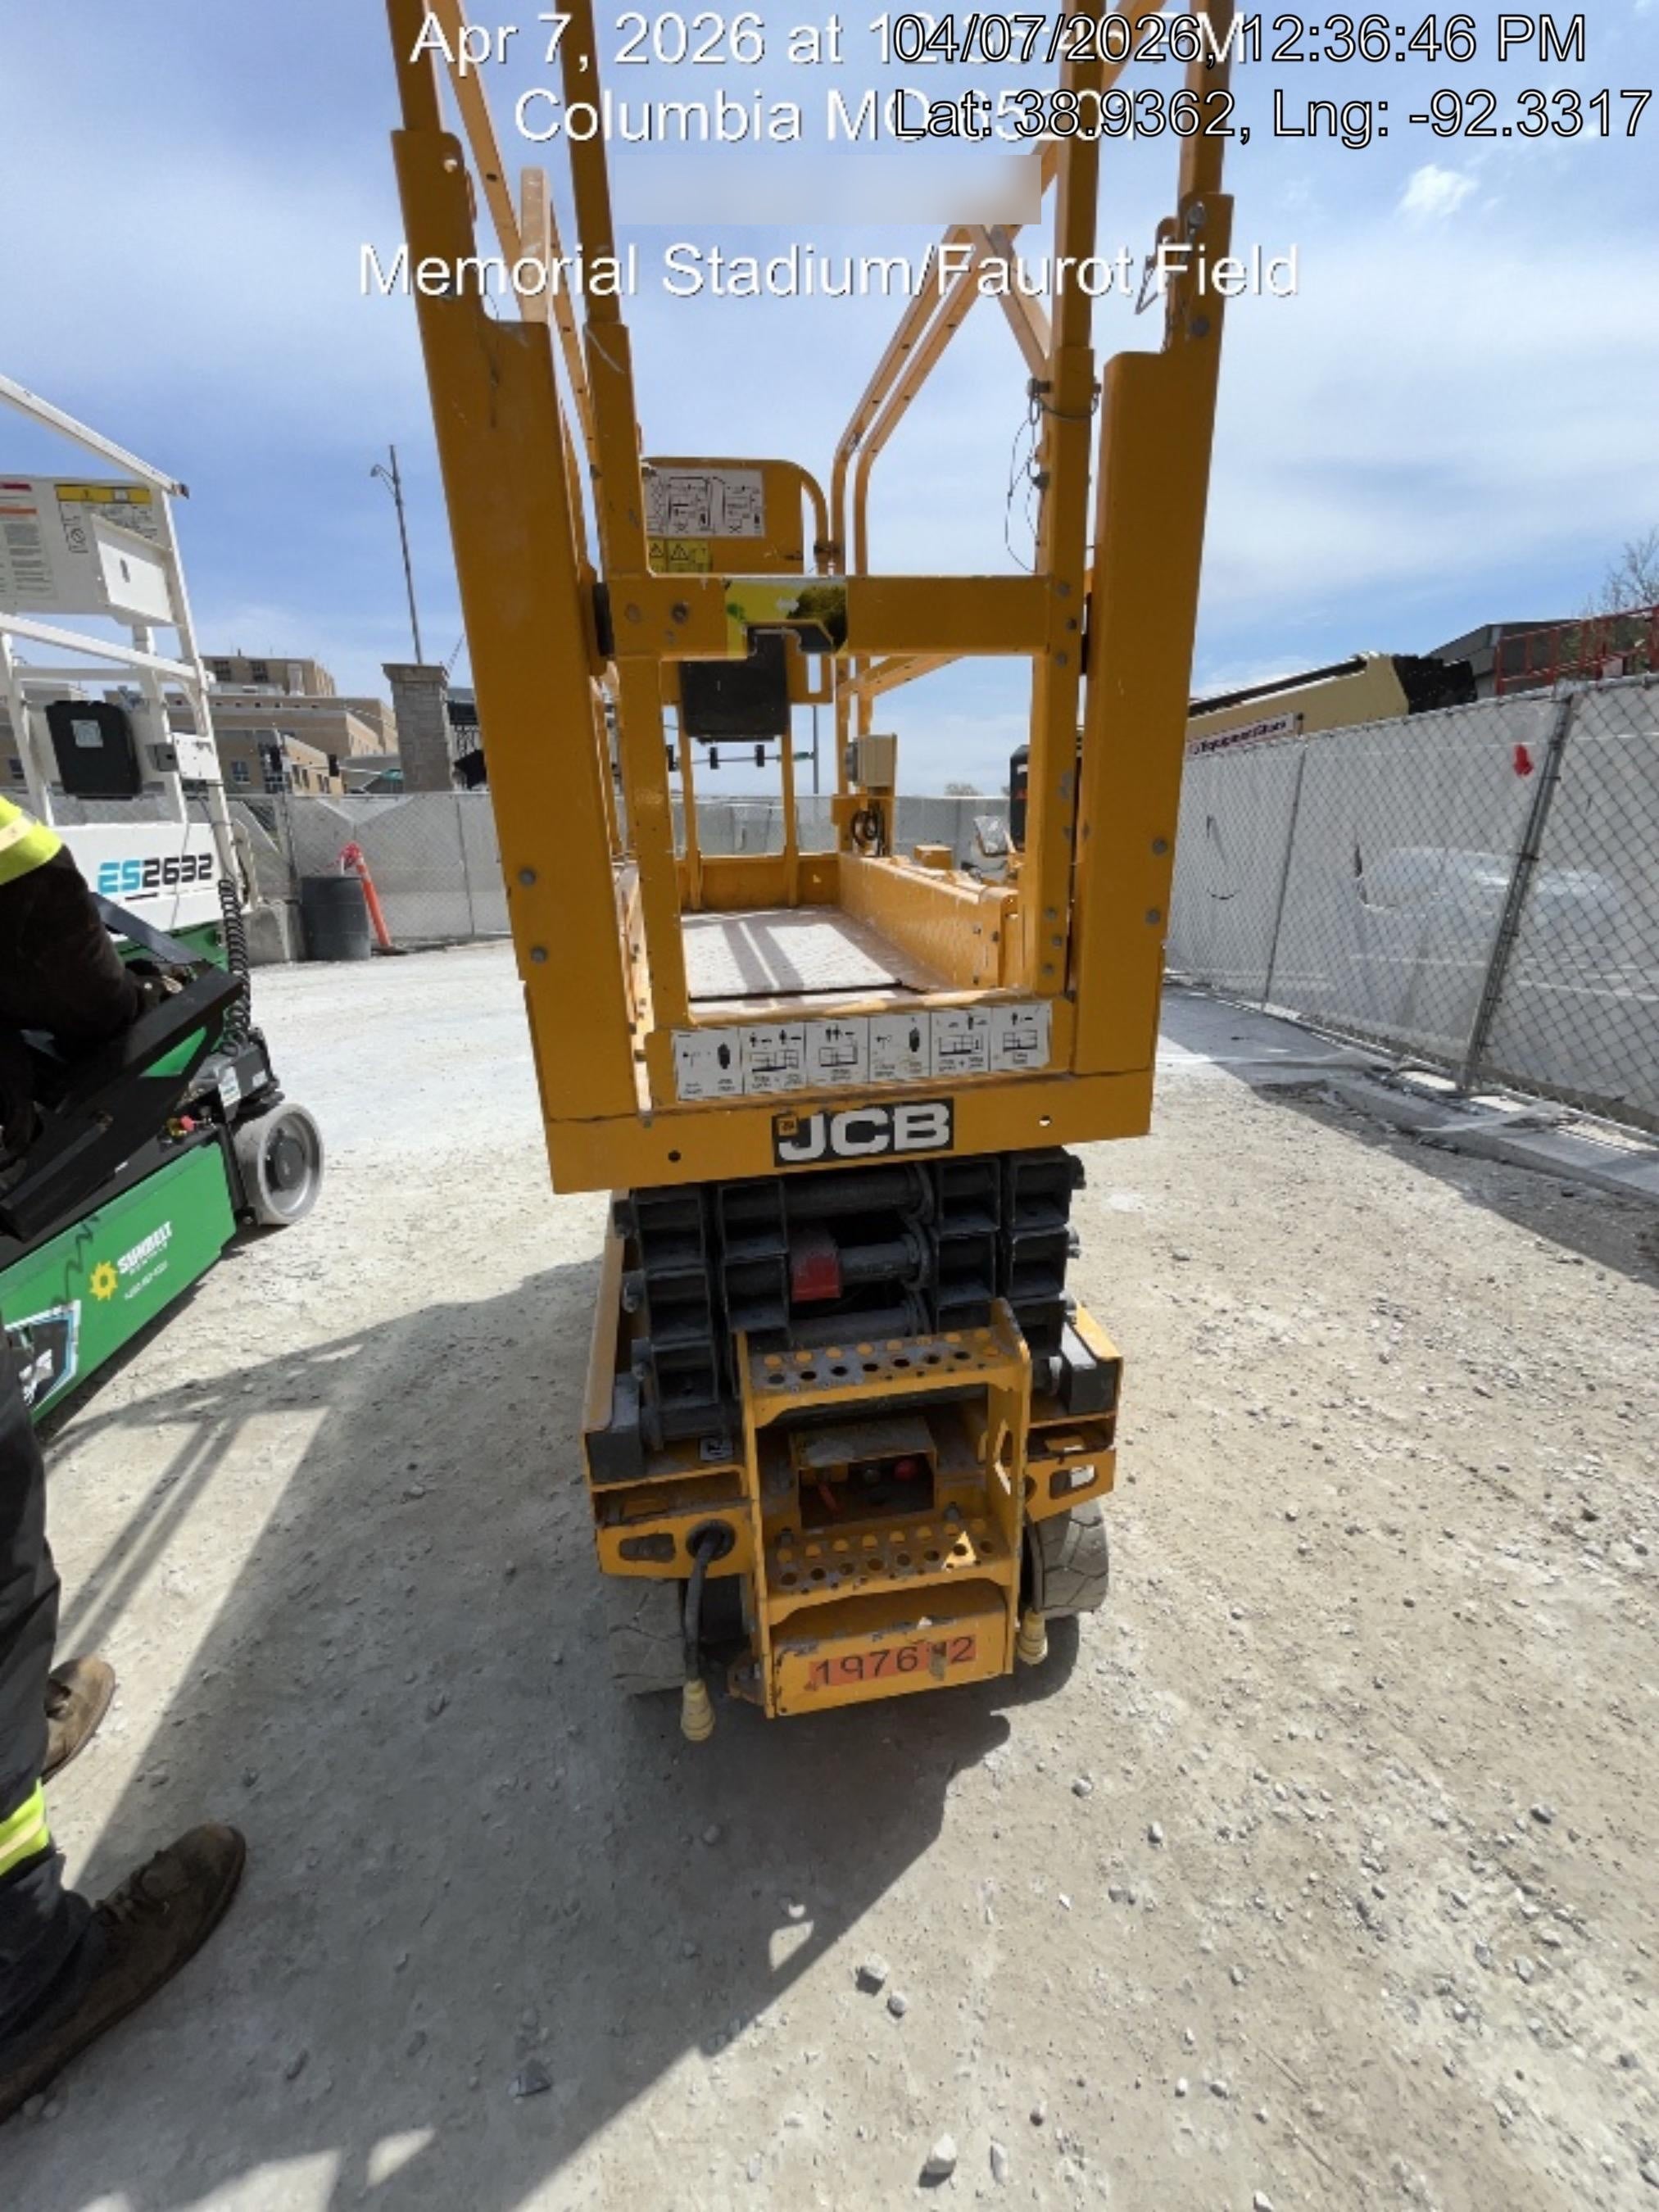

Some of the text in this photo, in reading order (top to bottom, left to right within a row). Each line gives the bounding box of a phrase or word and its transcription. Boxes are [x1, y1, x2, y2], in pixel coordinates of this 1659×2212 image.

[97, 852, 214, 894] ES2632
[777, 1102, 950, 1163] JCB
[814, 1637, 973, 1686] 19762
